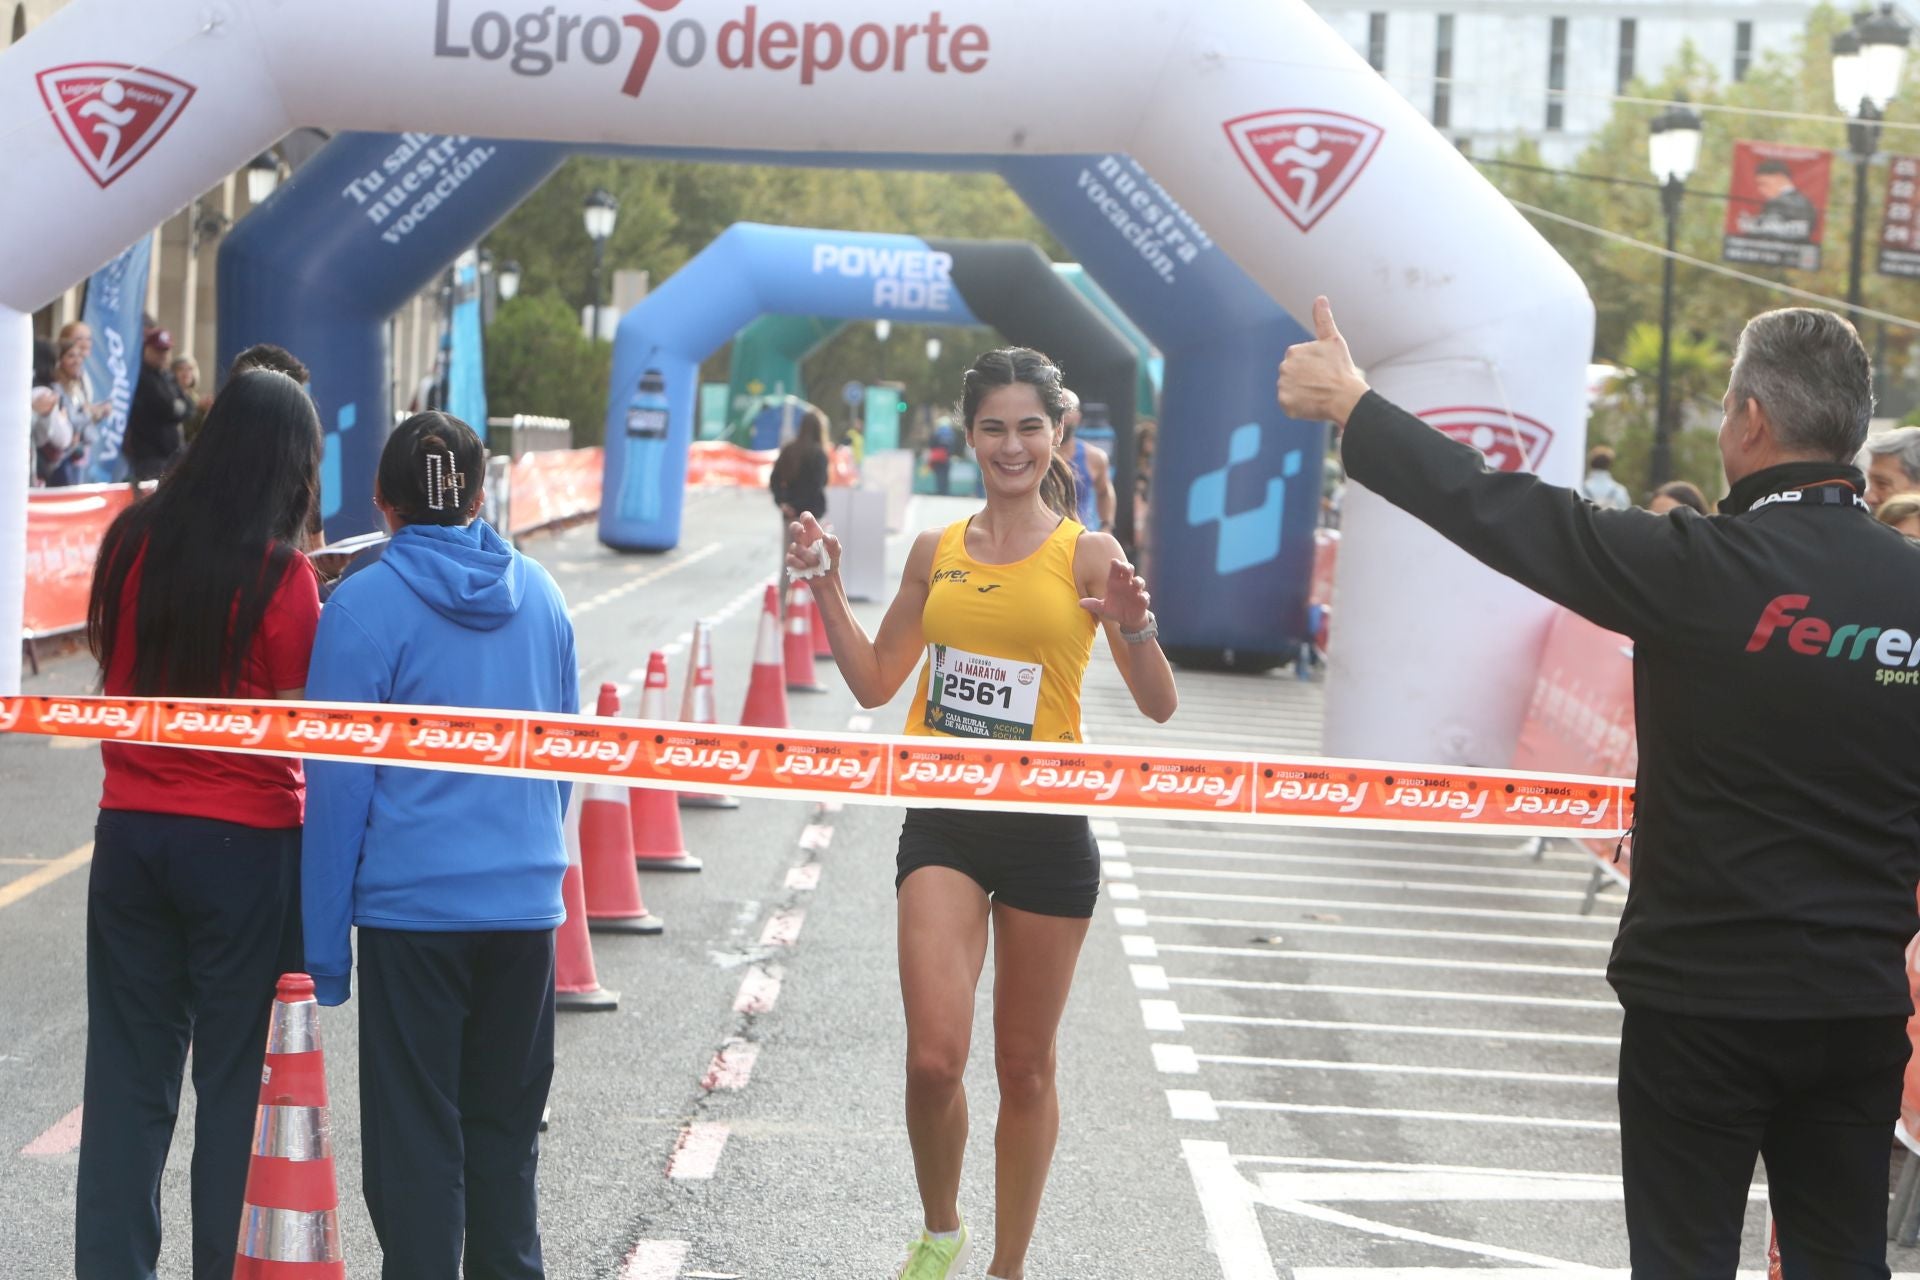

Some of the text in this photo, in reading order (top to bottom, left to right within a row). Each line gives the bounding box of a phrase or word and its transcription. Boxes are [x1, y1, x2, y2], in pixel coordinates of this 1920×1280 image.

[716, 5, 990, 85] deporte
[341, 131, 434, 205] Tu sal
[381, 146, 497, 244] vocación.
[1097, 155, 1199, 265] nuestra
[1077, 168, 1176, 285] vocación.
[812, 244, 954, 282] POWER
[873, 278, 950, 312] ADE
[99, 327, 131, 462] viamed
[1749, 490, 1802, 512] EAD
[954, 659, 964, 674] LA
[965, 663, 1007, 683] MARATÓN
[1875, 667, 1920, 687] sport
[943, 673, 1013, 709] 2561
[944, 719, 991, 737] DE NAVARRA
[945, 712, 988, 729] CAJA RURAL
